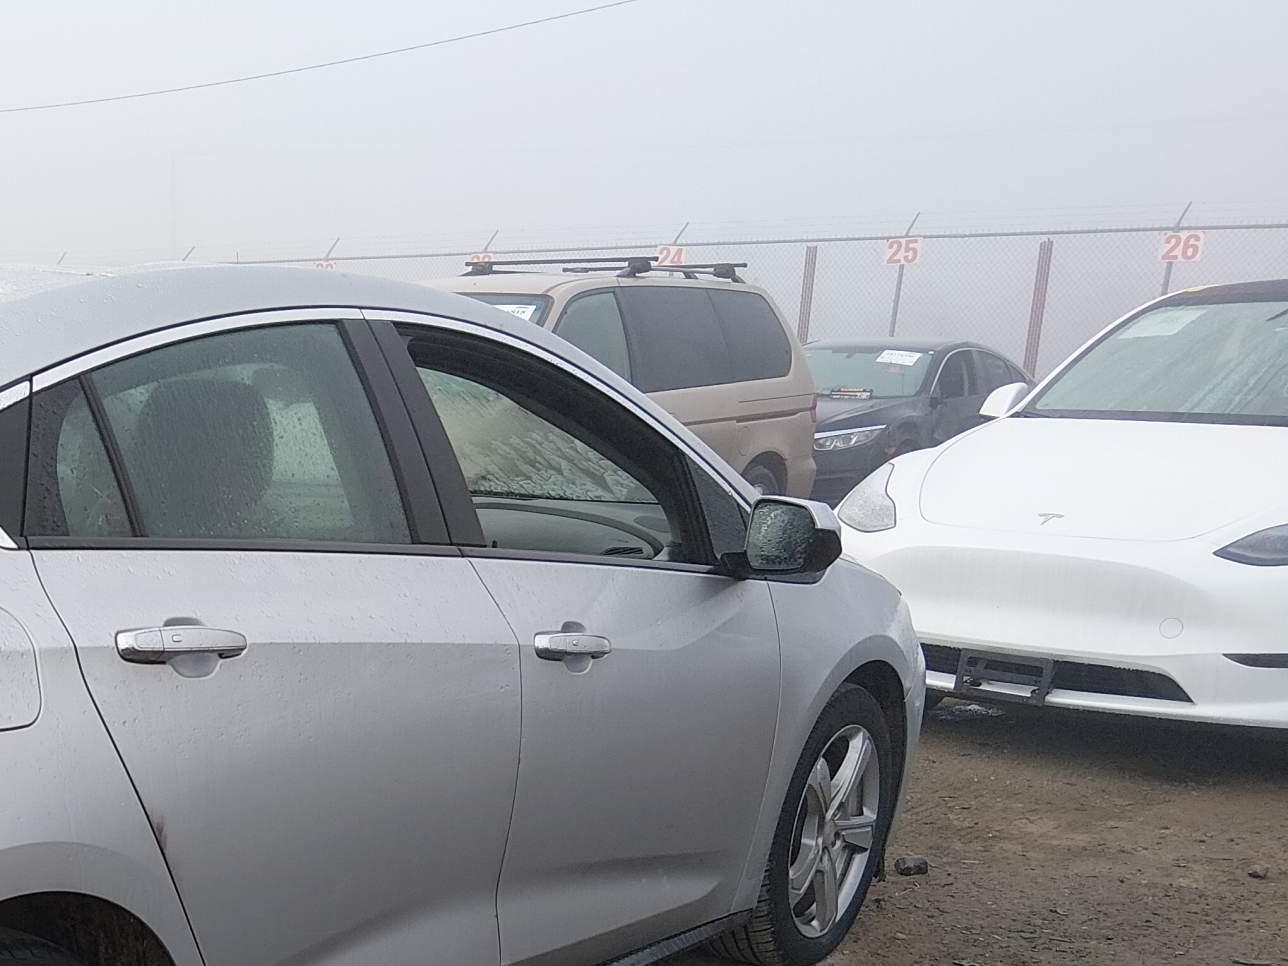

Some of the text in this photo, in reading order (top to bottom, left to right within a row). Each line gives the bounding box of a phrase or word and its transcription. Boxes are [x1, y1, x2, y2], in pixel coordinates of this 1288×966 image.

[658, 246, 683, 265] 24
[886, 239, 919, 264] 25
[1160, 233, 1201, 260] 26
